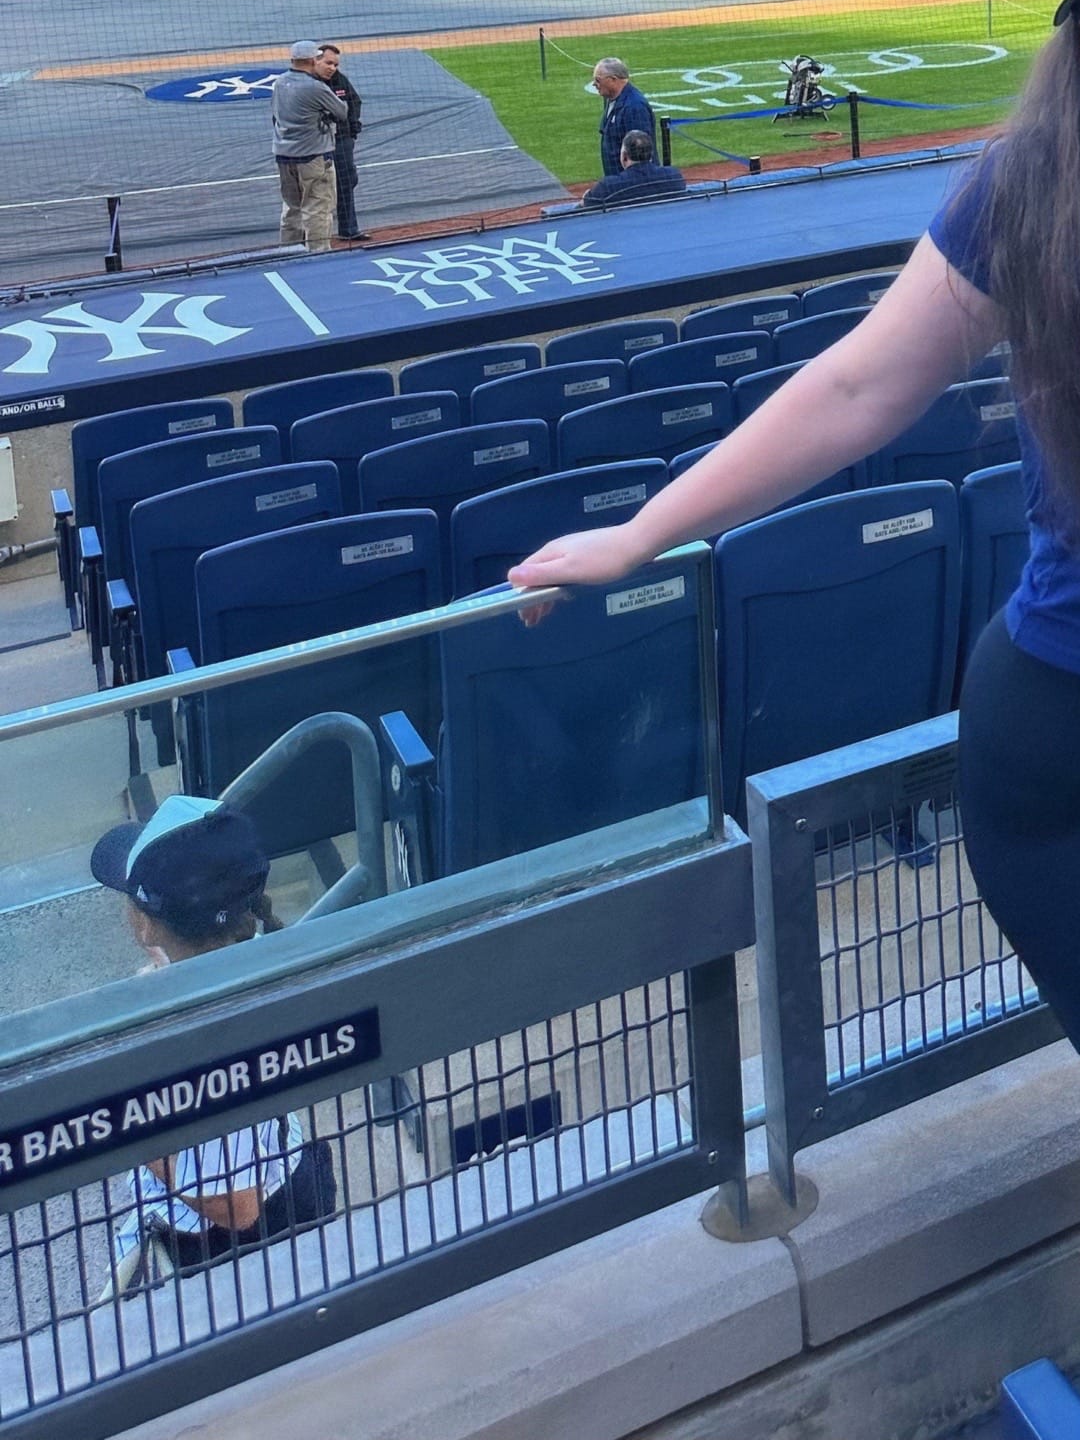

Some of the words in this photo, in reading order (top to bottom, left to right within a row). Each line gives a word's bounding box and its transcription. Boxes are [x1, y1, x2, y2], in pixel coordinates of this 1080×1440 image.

[352, 241, 621, 295] YORK
[373, 231, 560, 277] NEW
[416, 262, 615, 310] LIFE
[2, 403, 36, 417] AND/OR
[23, 1108, 113, 1165] BATS
[121, 1060, 251, 1135] AND/OR
[259, 1023, 357, 1082] BALLS
